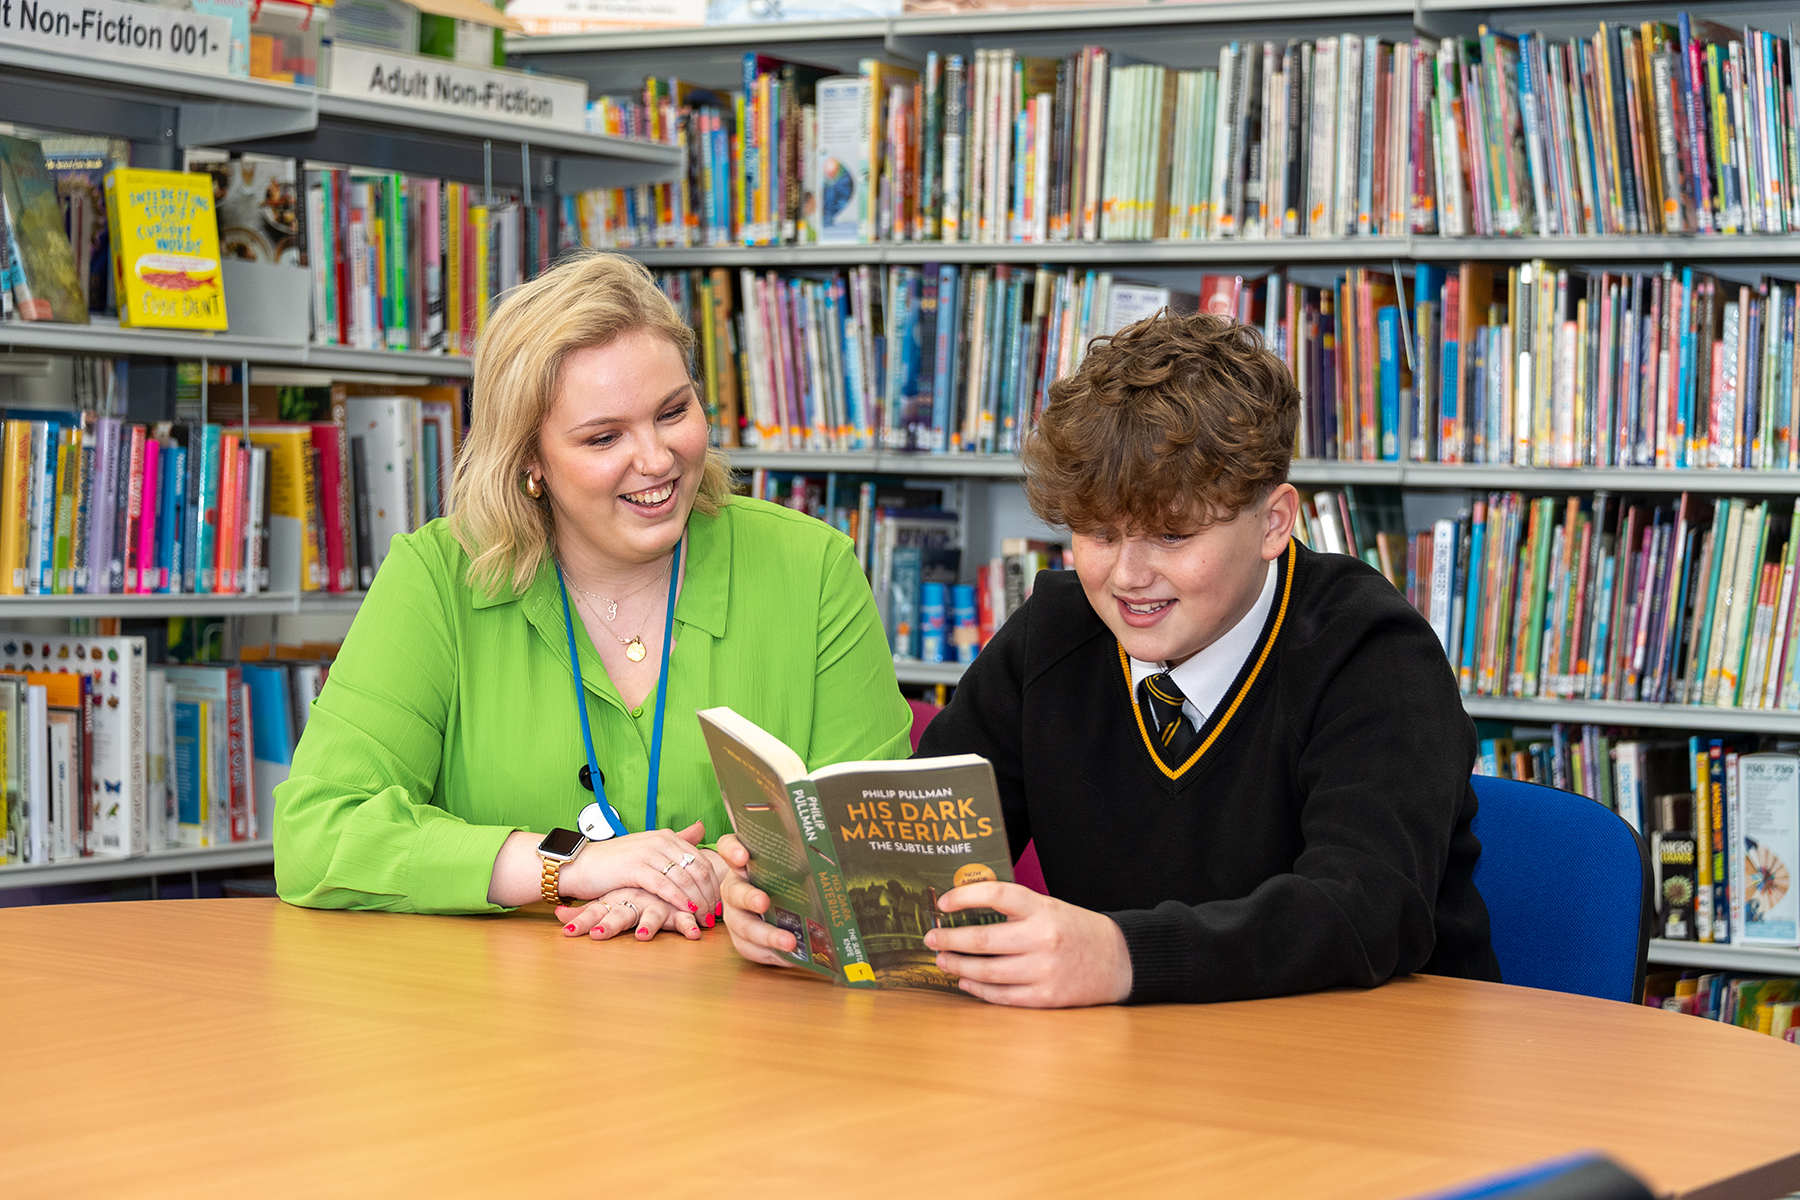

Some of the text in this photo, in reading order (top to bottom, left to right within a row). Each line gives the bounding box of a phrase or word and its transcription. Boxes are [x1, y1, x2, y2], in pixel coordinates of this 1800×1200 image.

[20, 0, 163, 51] Non-Fiction
[169, 22, 219, 57] 001-
[369, 62, 554, 119] Adult Non-Fiction
[131, 664, 145, 825] NATURAL HISTORY
[229, 687, 244, 788] BRYSON
[846, 797, 977, 822] HIS DARK
[862, 787, 953, 799] PHILIP PULLMAN
[792, 789, 819, 842] PULLMAN
[806, 796, 826, 830] PHILIP
[839, 816, 993, 842] MATERIALS
[869, 841, 972, 854] THE SUBTLE KNIFE
[1660, 839, 1695, 854] MICRO
[818, 871, 845, 928] MATERIALS
[830, 874, 854, 921] HIS DARK
[842, 938, 855, 957] KNIFE
[847, 928, 858, 941] THE
